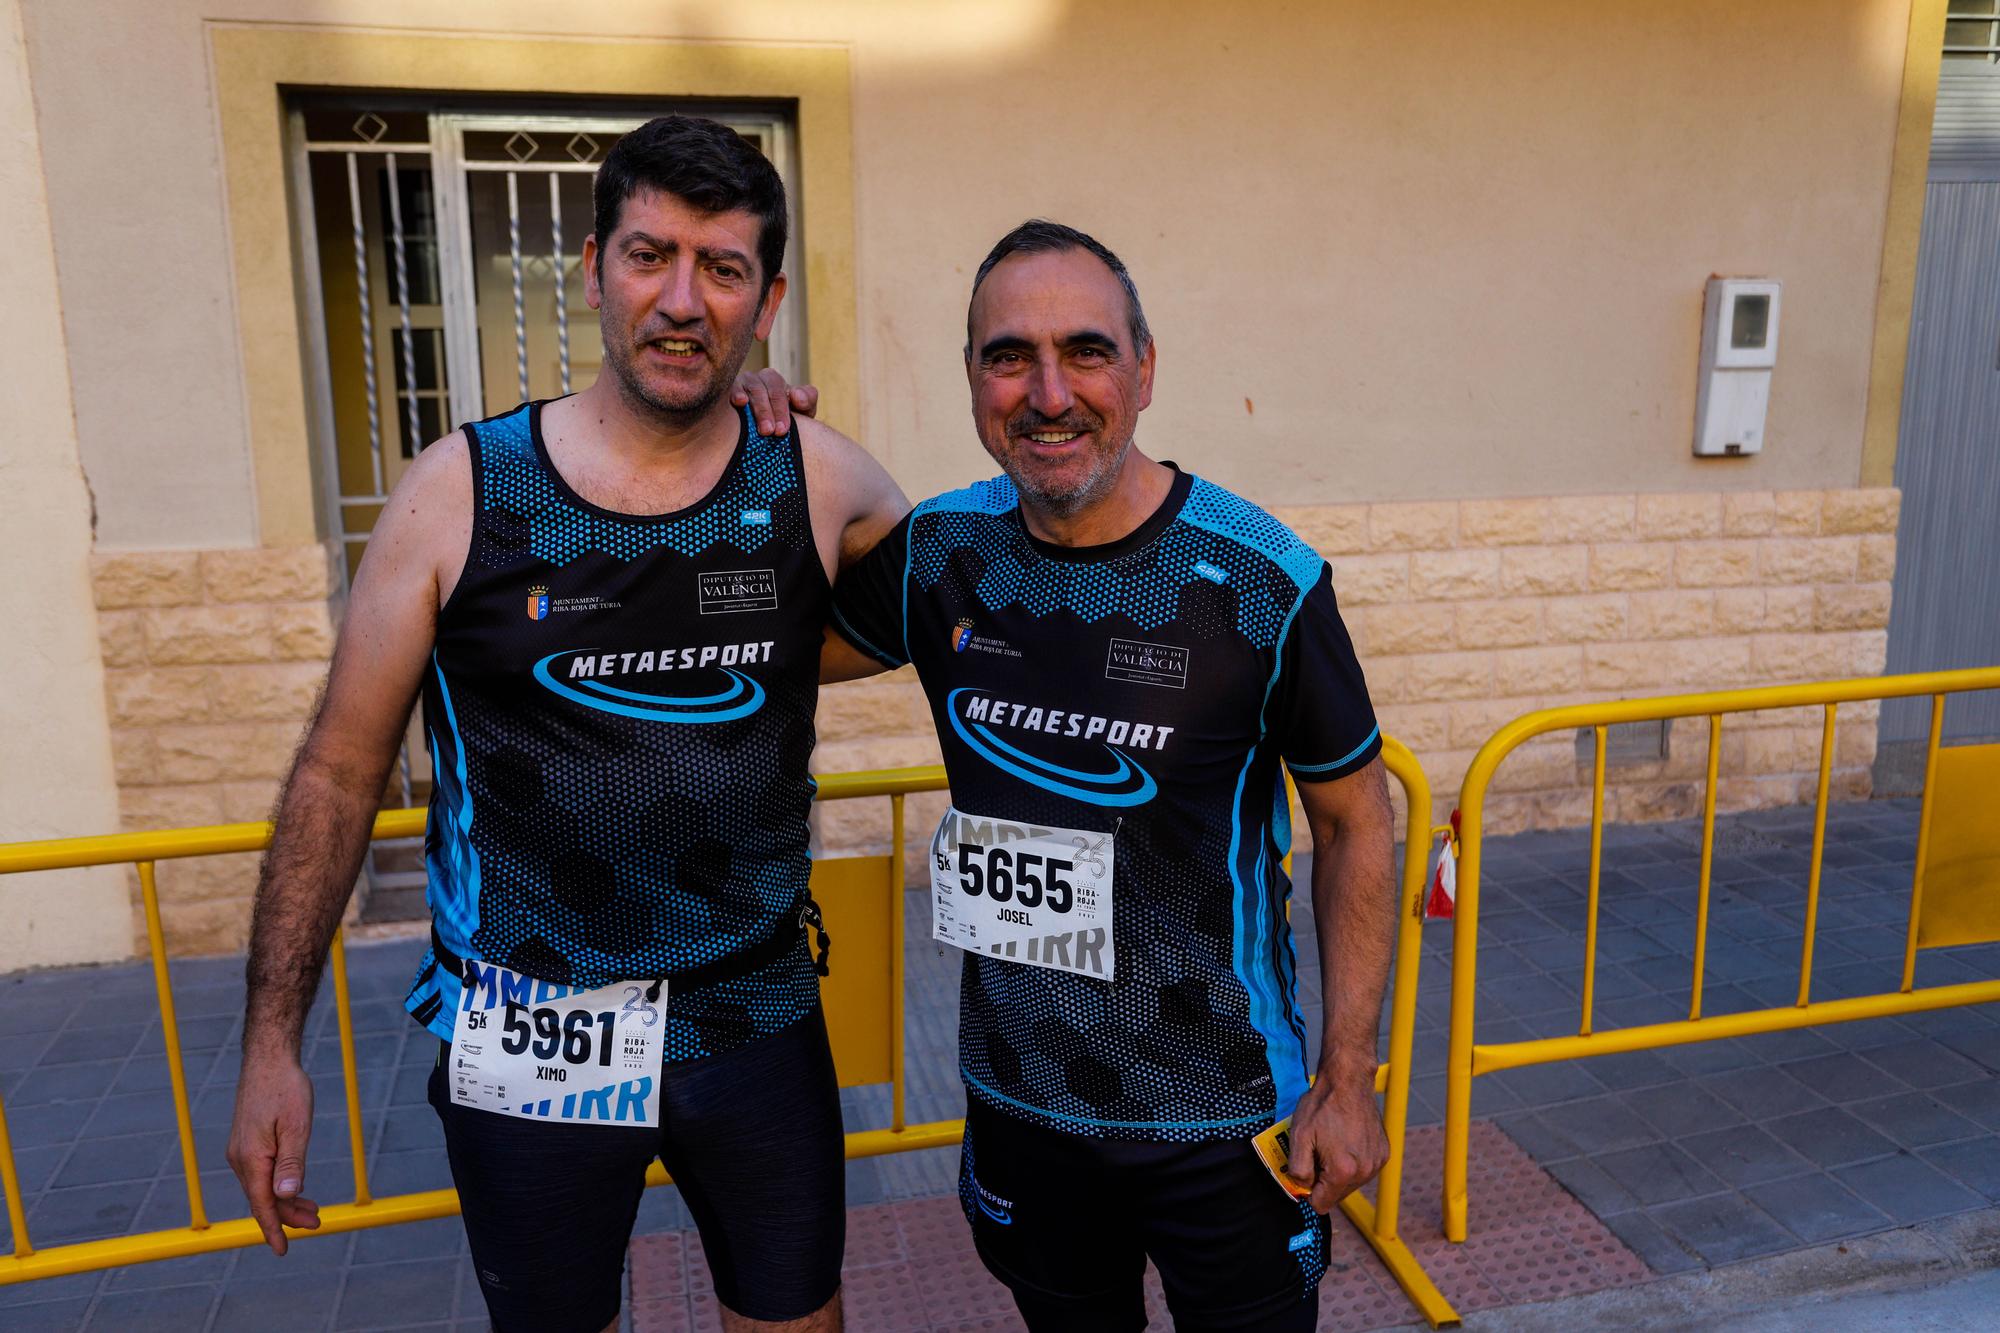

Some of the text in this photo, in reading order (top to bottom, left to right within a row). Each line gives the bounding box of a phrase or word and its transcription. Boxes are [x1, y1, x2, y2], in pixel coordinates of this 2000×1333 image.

[1197, 565, 1224, 581] 42K
[568, 640, 776, 679] METAESPORT
[965, 696, 1175, 751] METAESPORT
[958, 843, 1074, 914] 5655
[996, 907, 1033, 927] JOSEL
[501, 1000, 617, 1067] 5961
[536, 1065, 567, 1083] XIMO
